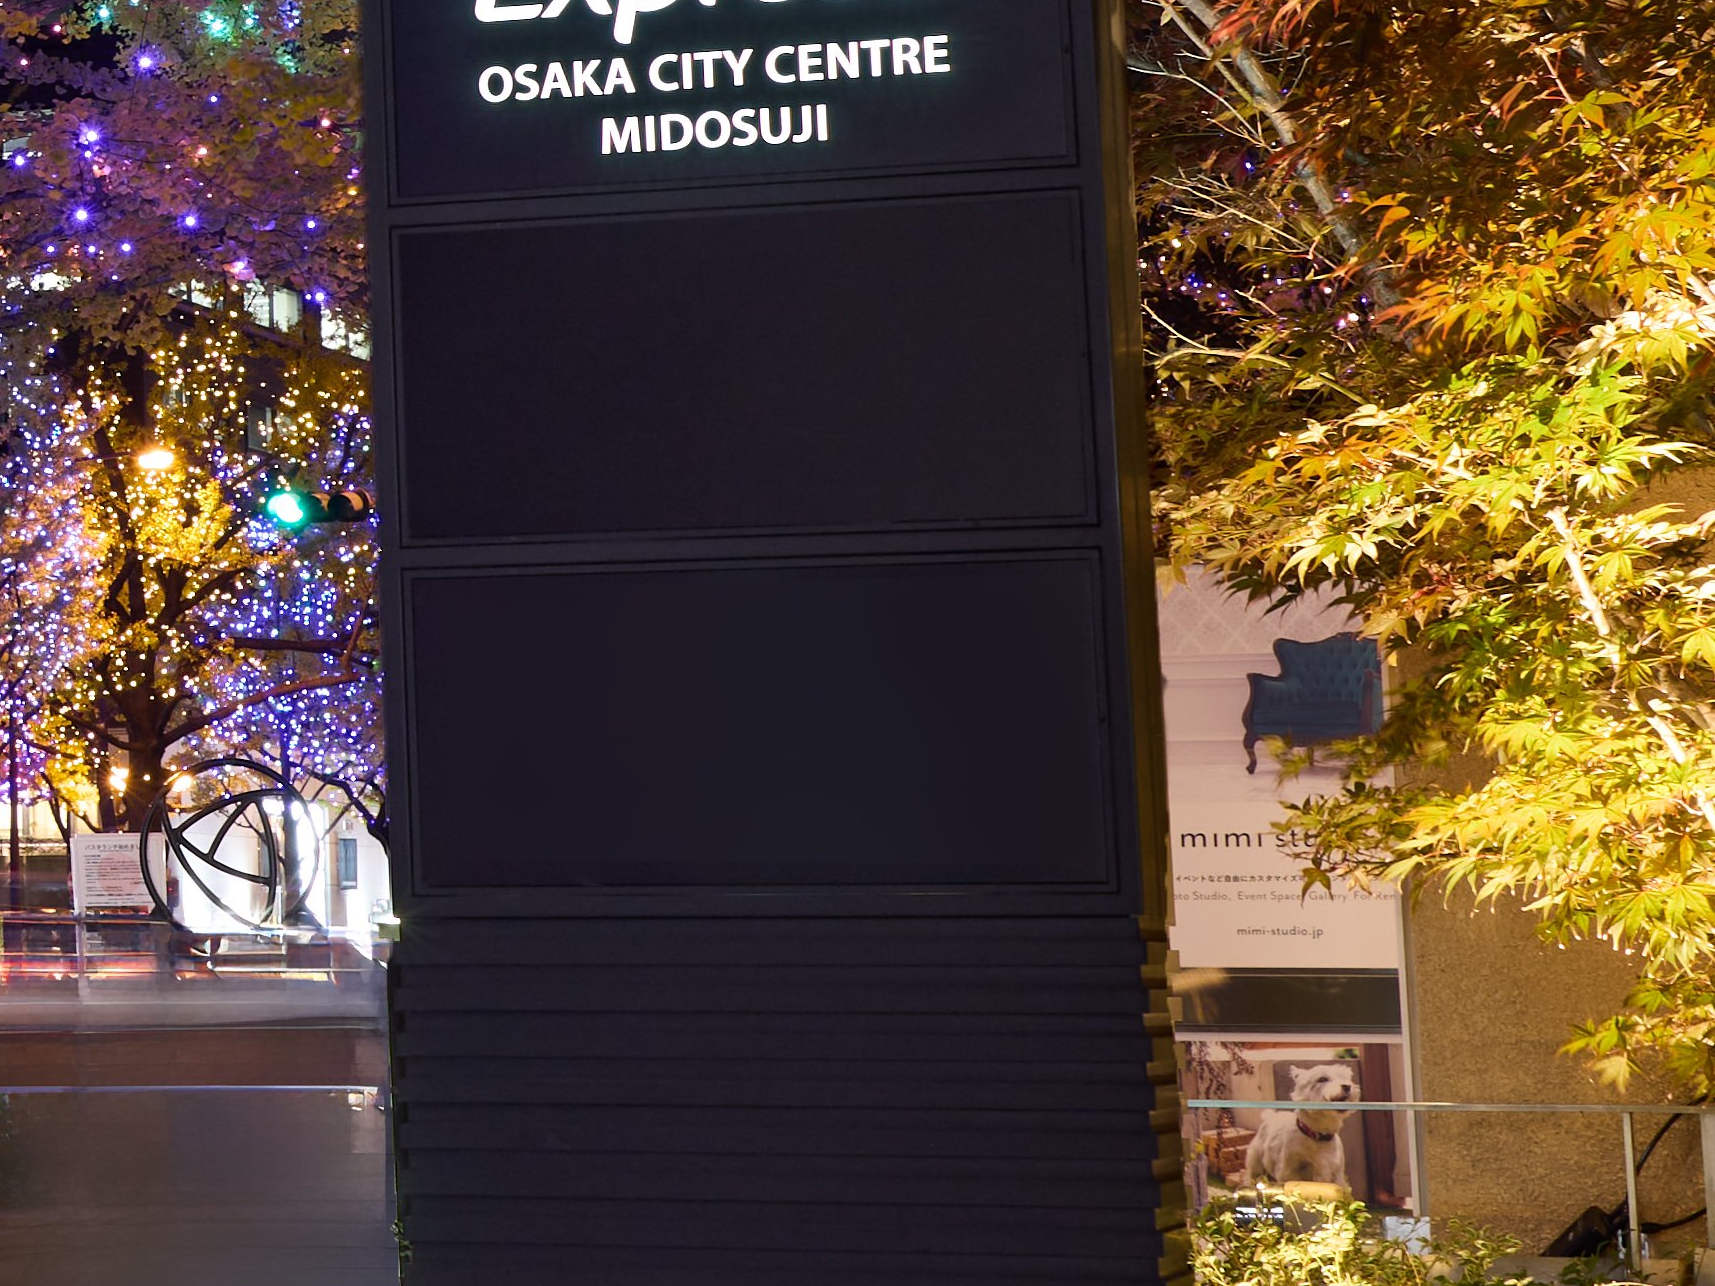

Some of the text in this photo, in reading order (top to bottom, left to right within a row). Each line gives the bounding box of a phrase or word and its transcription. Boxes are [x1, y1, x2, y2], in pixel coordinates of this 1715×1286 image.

[478, 34, 951, 103] OSAKA CITY CENTRE
[601, 103, 829, 155] MIDOSUJI
[1237, 891, 1268, 901] Event
[1236, 925, 1324, 939] mimi-studio.jp
